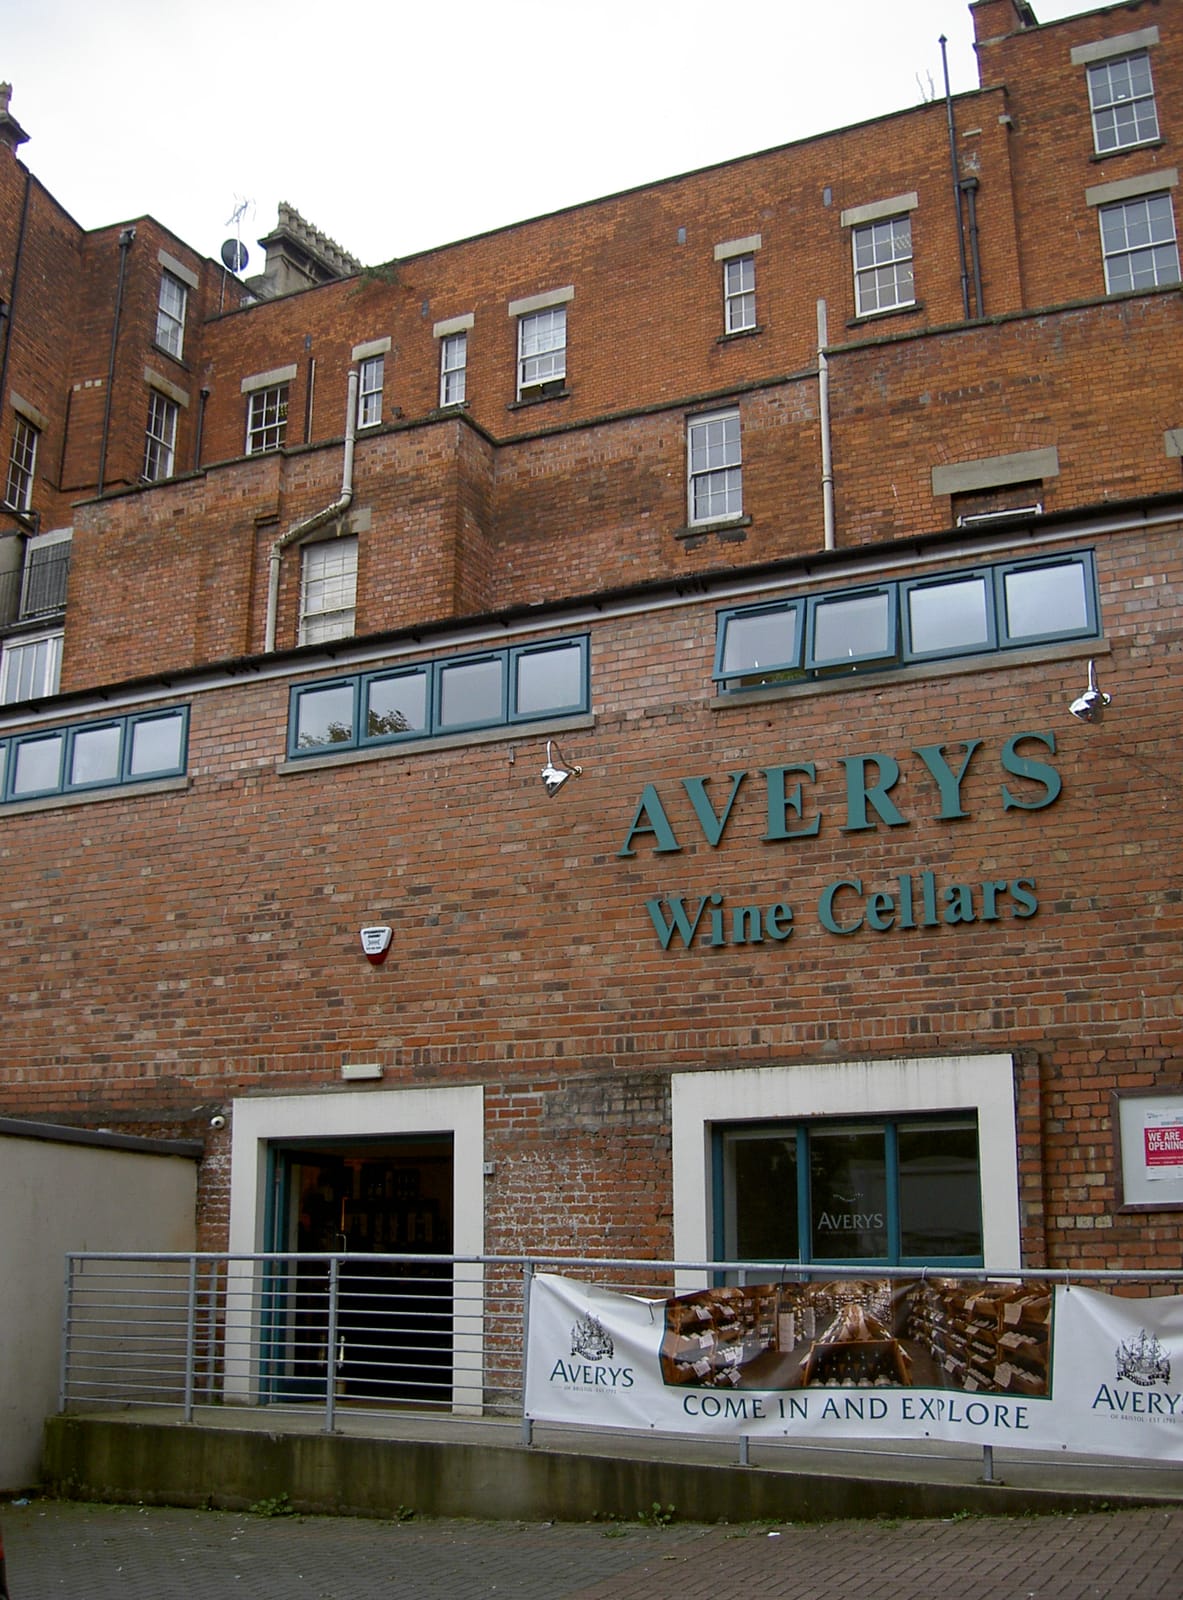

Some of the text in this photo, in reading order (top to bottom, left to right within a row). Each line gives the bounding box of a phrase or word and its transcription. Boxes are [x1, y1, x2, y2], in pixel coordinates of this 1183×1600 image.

[615, 730, 1063, 858] AVERYS
[645, 871, 1039, 951] Wine Cellars
[1148, 1131, 1180, 1142] WE ARE
[817, 1211, 884, 1230] AVERYS
[550, 1359, 634, 1387] AVERYS
[683, 1395, 1030, 1429] COME IN AND EXPLORE
[1091, 1383, 1183, 1415] AVERY
